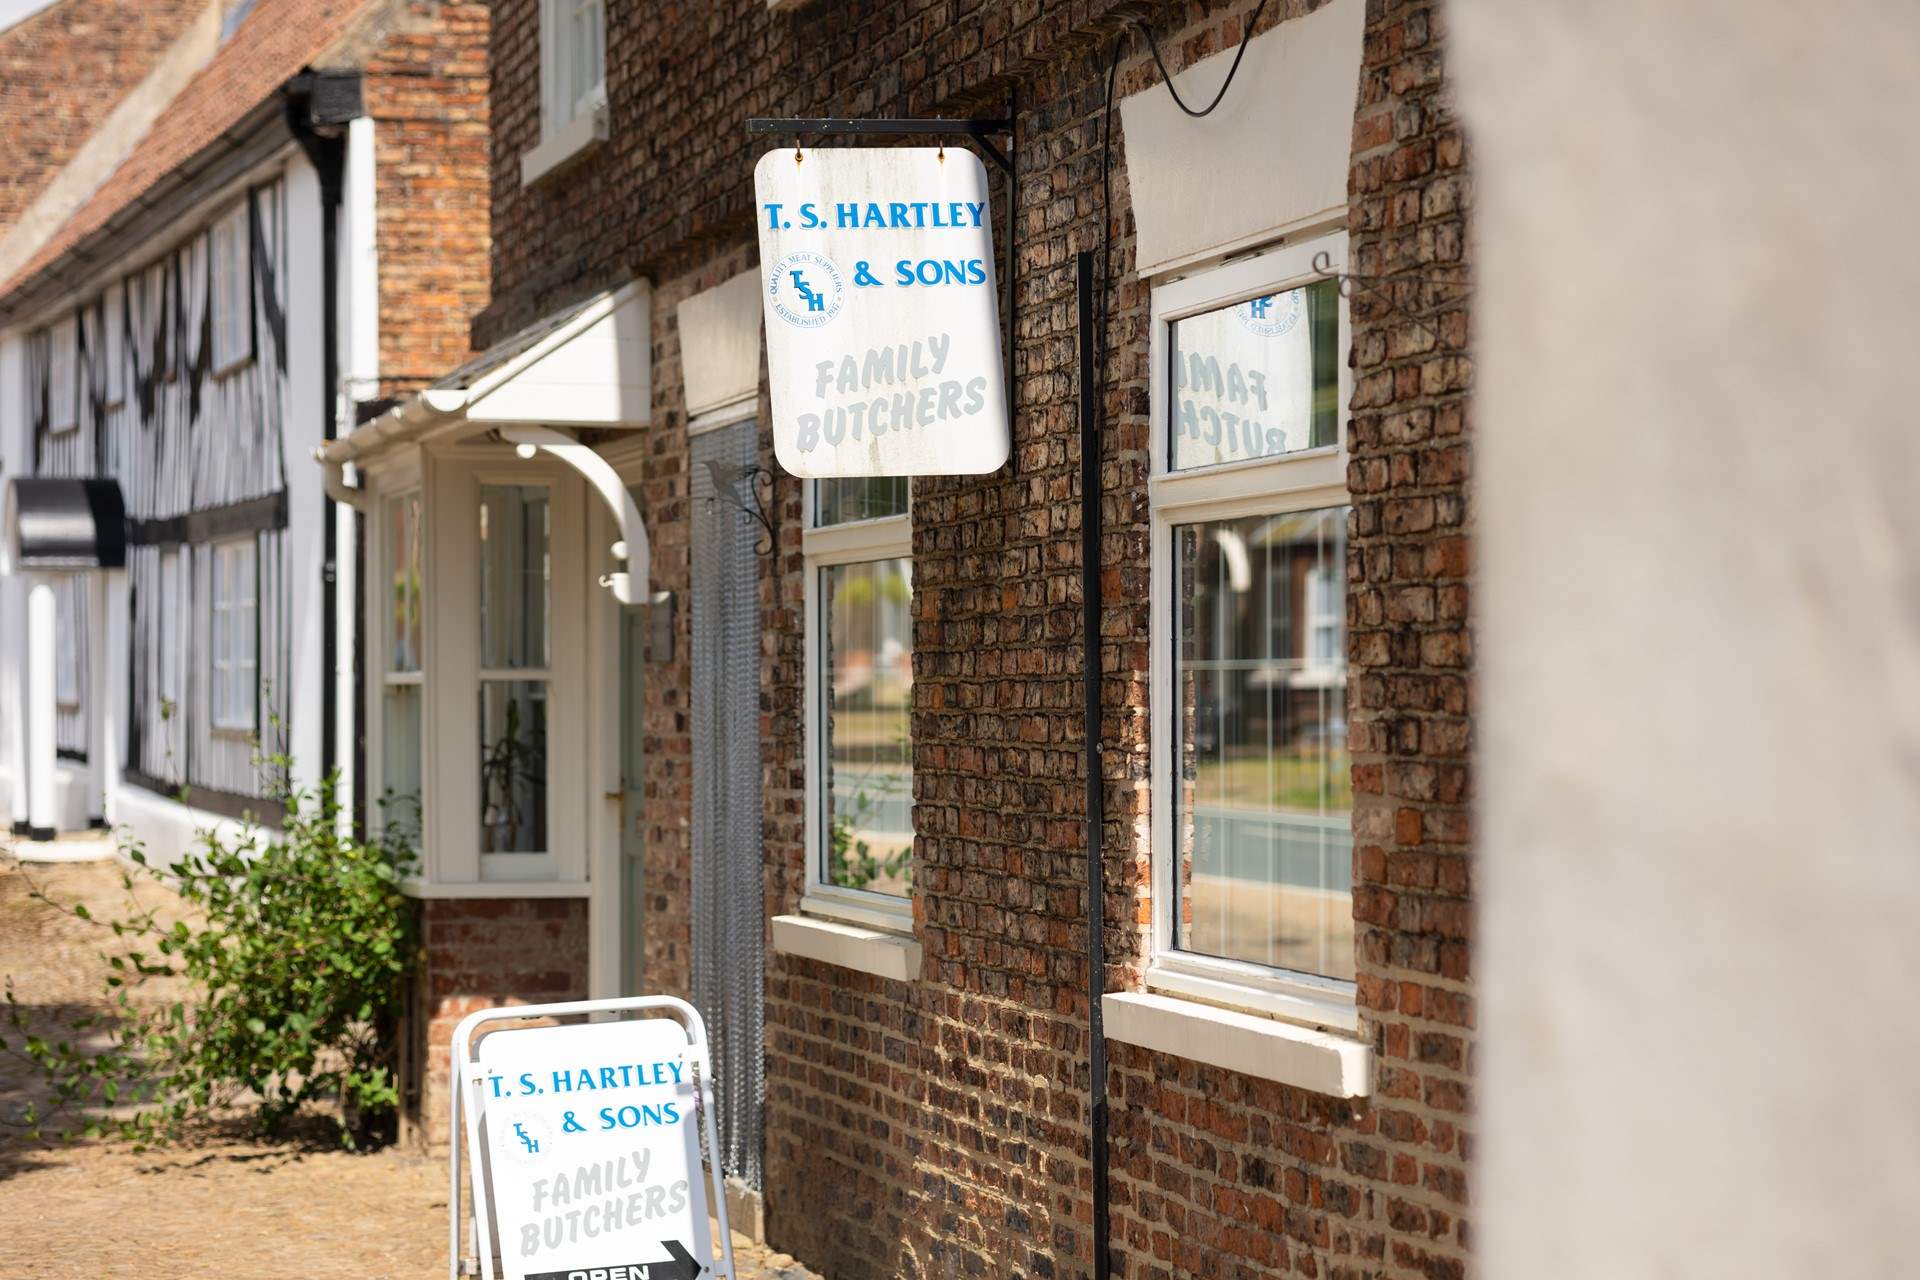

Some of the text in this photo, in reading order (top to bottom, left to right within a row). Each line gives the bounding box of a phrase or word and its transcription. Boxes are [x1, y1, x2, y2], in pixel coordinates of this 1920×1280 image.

[764, 202, 985, 229] T. S. HARTLEY
[769, 254, 842, 295] QUALITY MEAT SUPPLIERS
[854, 259, 987, 286] & SONS
[776, 303, 826, 326] ESTABLISHED
[816, 333, 950, 399] FAMILY
[797, 377, 987, 455] BUTCHERS
[489, 1061, 683, 1097] T. S. HARTLEY
[562, 1102, 680, 1133] & SONS
[532, 1147, 650, 1213] FAMILY
[520, 1180, 688, 1257] BUTCHERS
[568, 1265, 649, 1280] OPEN
